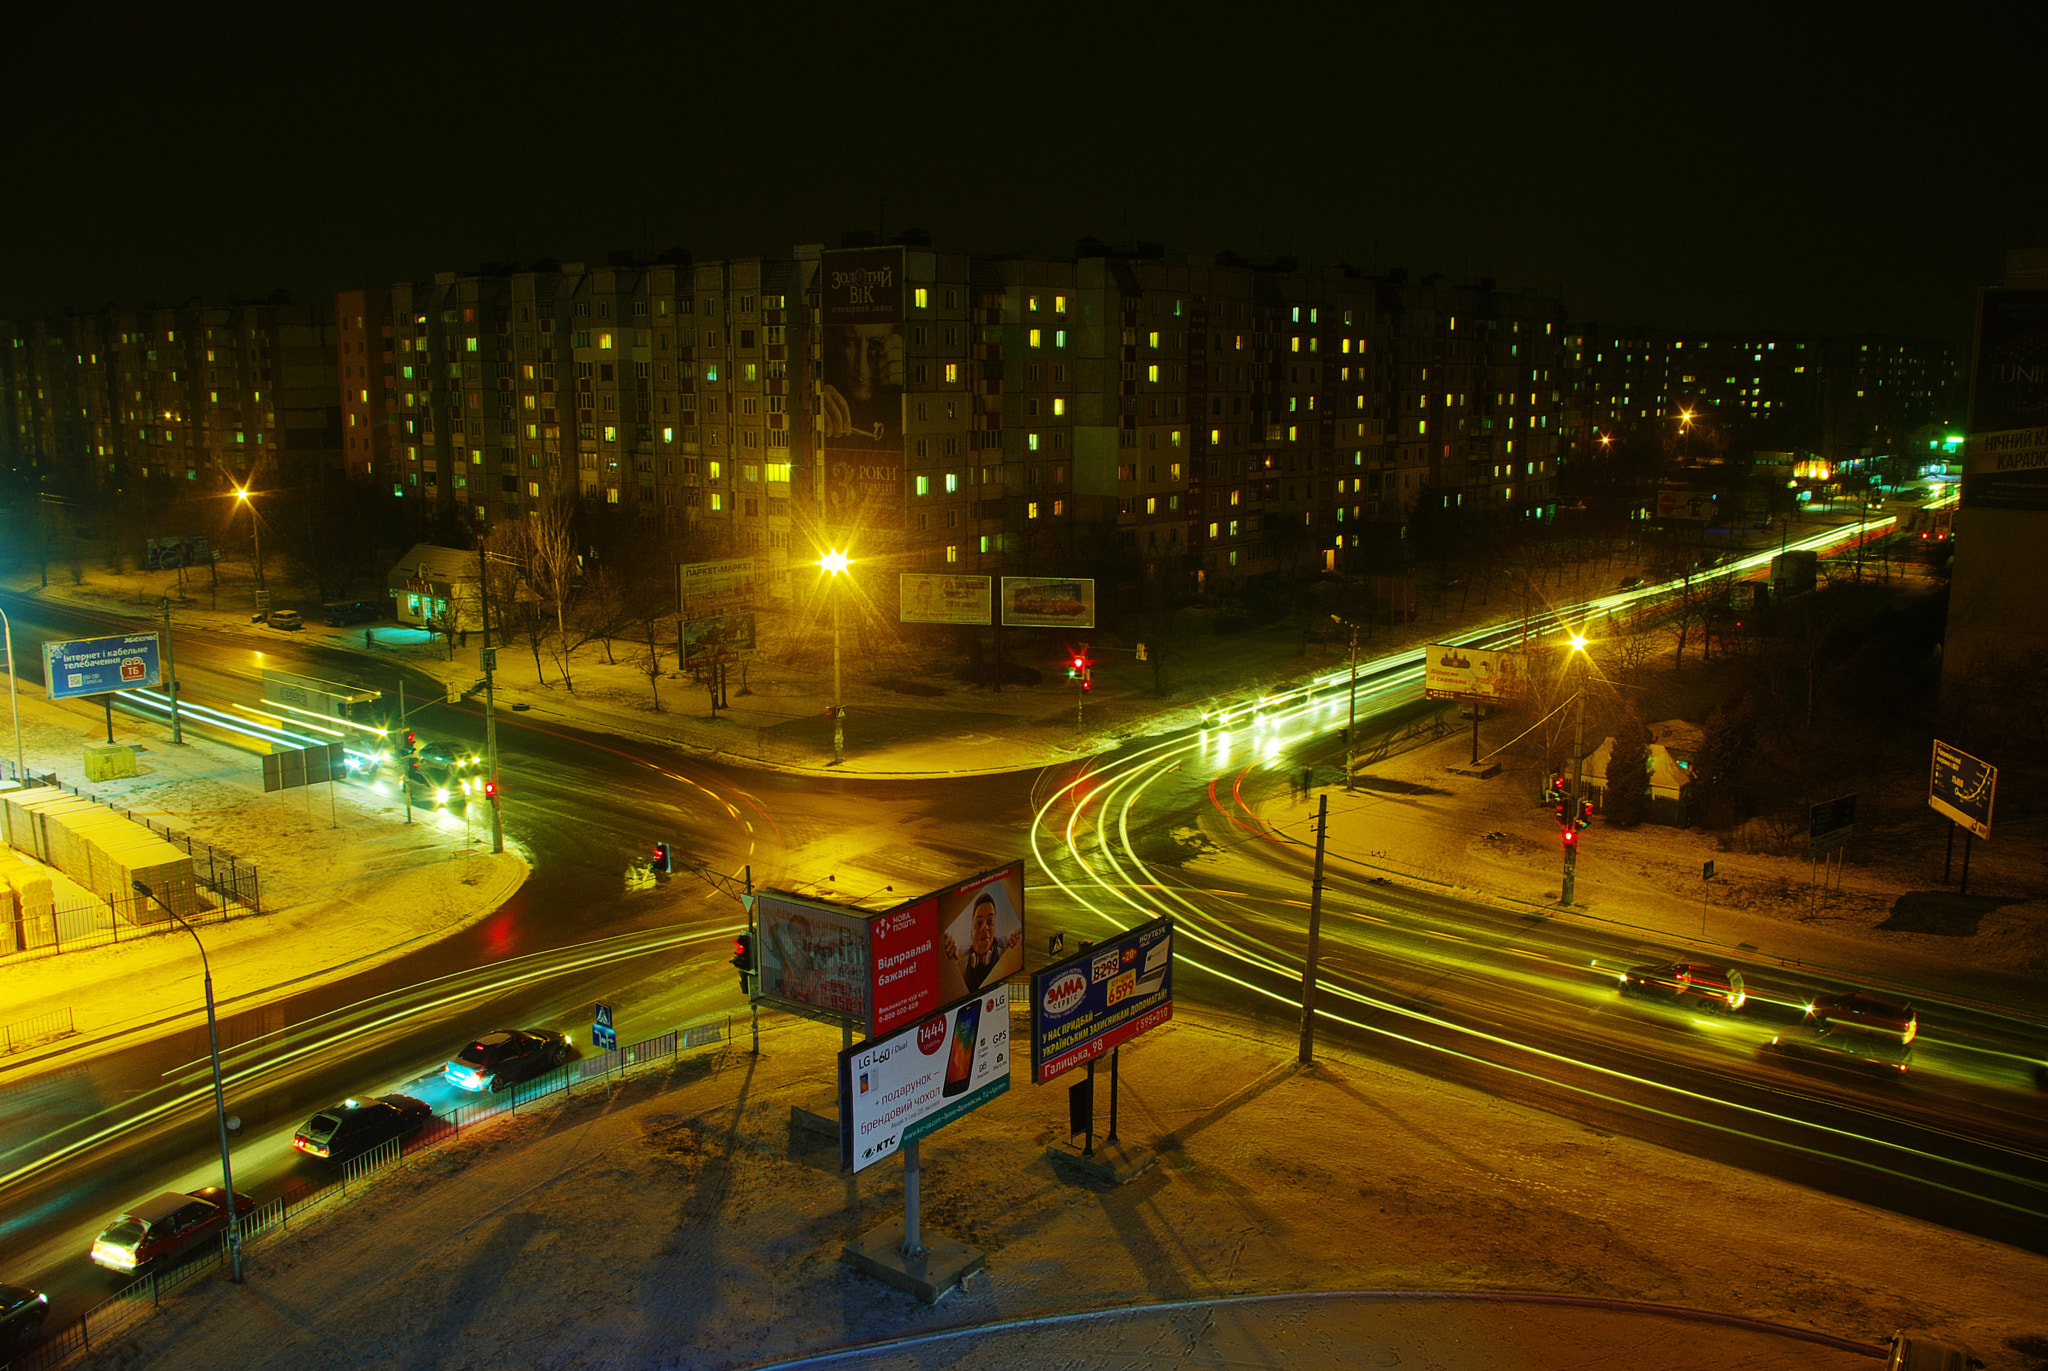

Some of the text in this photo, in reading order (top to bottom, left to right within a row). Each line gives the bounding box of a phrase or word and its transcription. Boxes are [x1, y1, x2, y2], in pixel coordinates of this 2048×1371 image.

[1985, 430, 2032, 451] НІЧНИЙ
[686, 563, 752, 577] ПАРКЕТ-МАРКЕТ
[63, 652, 101, 662] Інтернет
[107, 646, 148, 657] кабельне
[64, 657, 120, 670] телебачення
[127, 667, 139, 676] ТБ
[893, 912, 910, 924] НОВА
[893, 918, 916, 932] ПОШТА
[878, 940, 932, 970] Відправляй
[878, 962, 917, 986] бажане!
[996, 995, 1005, 1007] LG
[1053, 993, 1078, 1009] СЕРВІС
[1108, 979, 1134, 1004] 6599
[919, 1021, 945, 1043] 1444
[993, 1030, 1007, 1044] GPS
[1043, 1033, 1048, 1044] У
[1048, 1026, 1061, 1040] НАС
[1062, 1010, 1094, 1035] ПРИДБАЙ
[1043, 1027, 1089, 1057] УКРАЇНСЬКИМ
[1090, 1008, 1130, 1036] ЗАХИСНИКАМ
[858, 1055, 871, 1070] LG
[894, 1040, 908, 1053] Dual
[1045, 1039, 1103, 1077] Галицька, 98
[881, 1072, 932, 1105] подарунок
[861, 1086, 941, 1135] брендовий чохол
